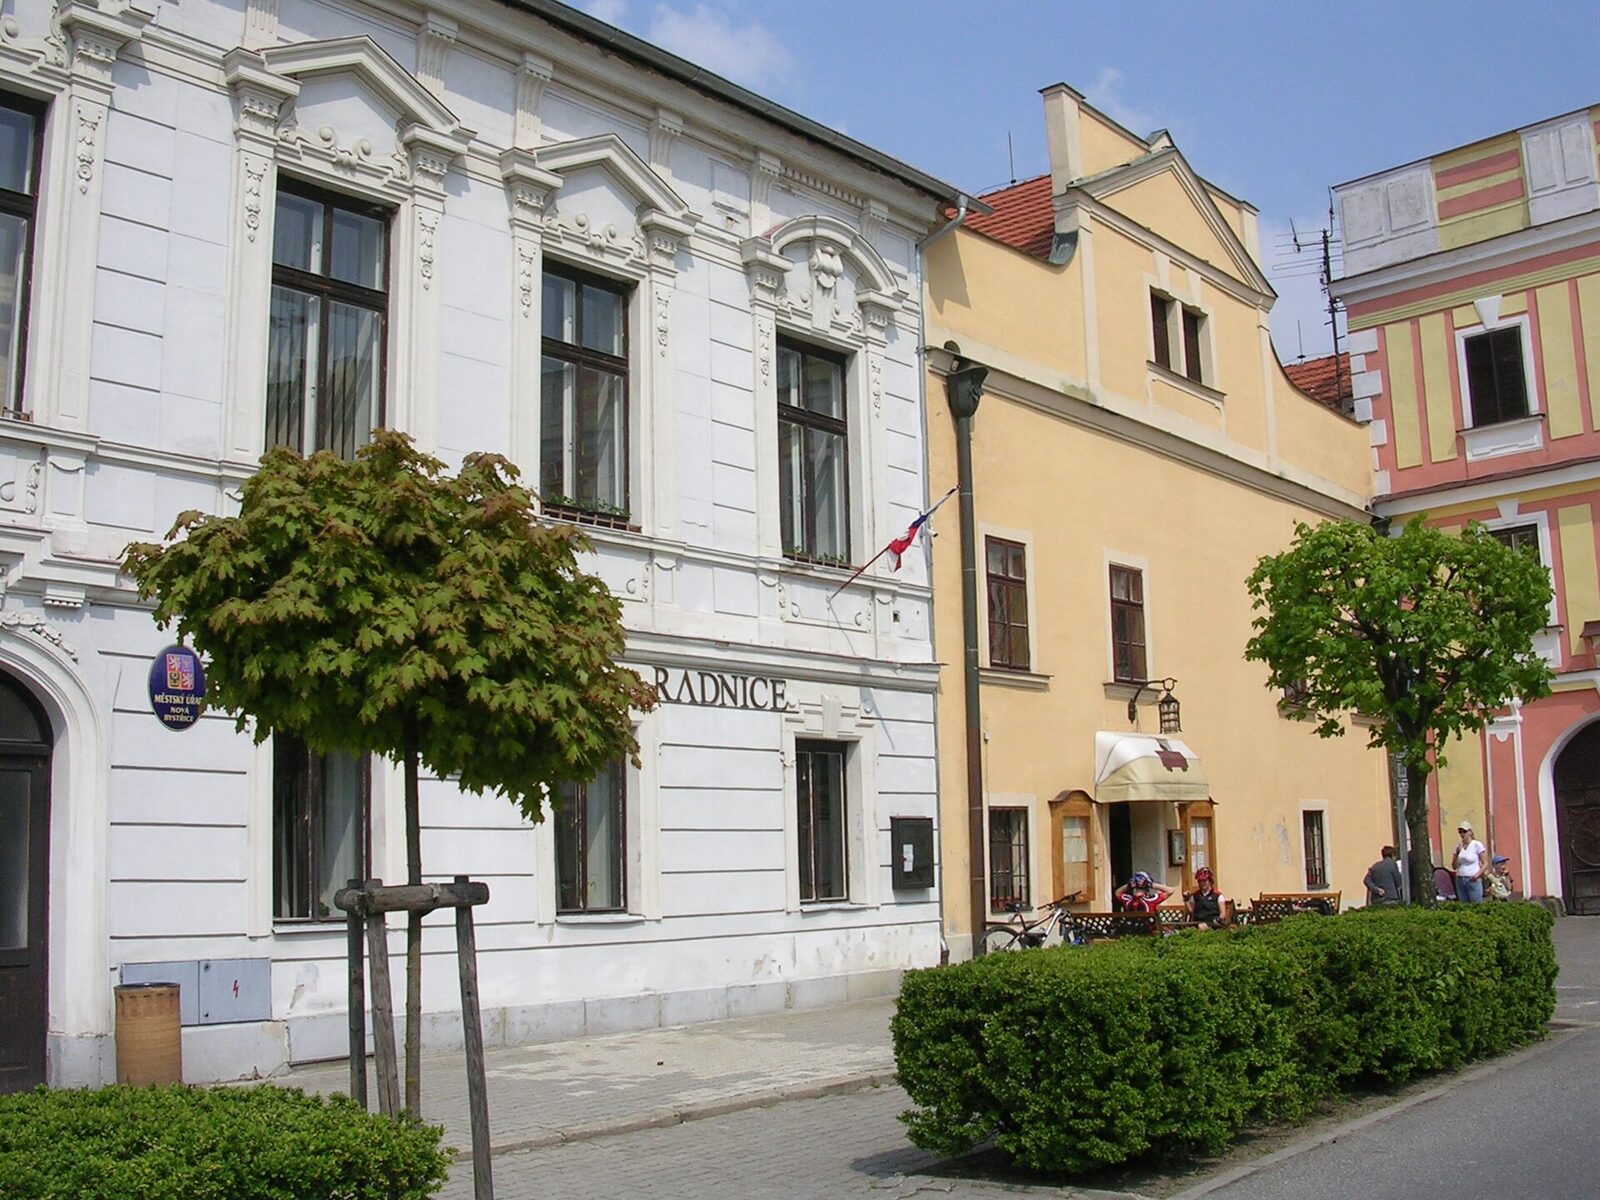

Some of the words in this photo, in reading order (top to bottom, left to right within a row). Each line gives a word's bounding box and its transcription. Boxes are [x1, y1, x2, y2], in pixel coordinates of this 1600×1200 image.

[653, 666, 789, 711] RADNICE
[154, 693, 184, 704] MĚSTSKÝ
[170, 706, 189, 714] NOVÁ
